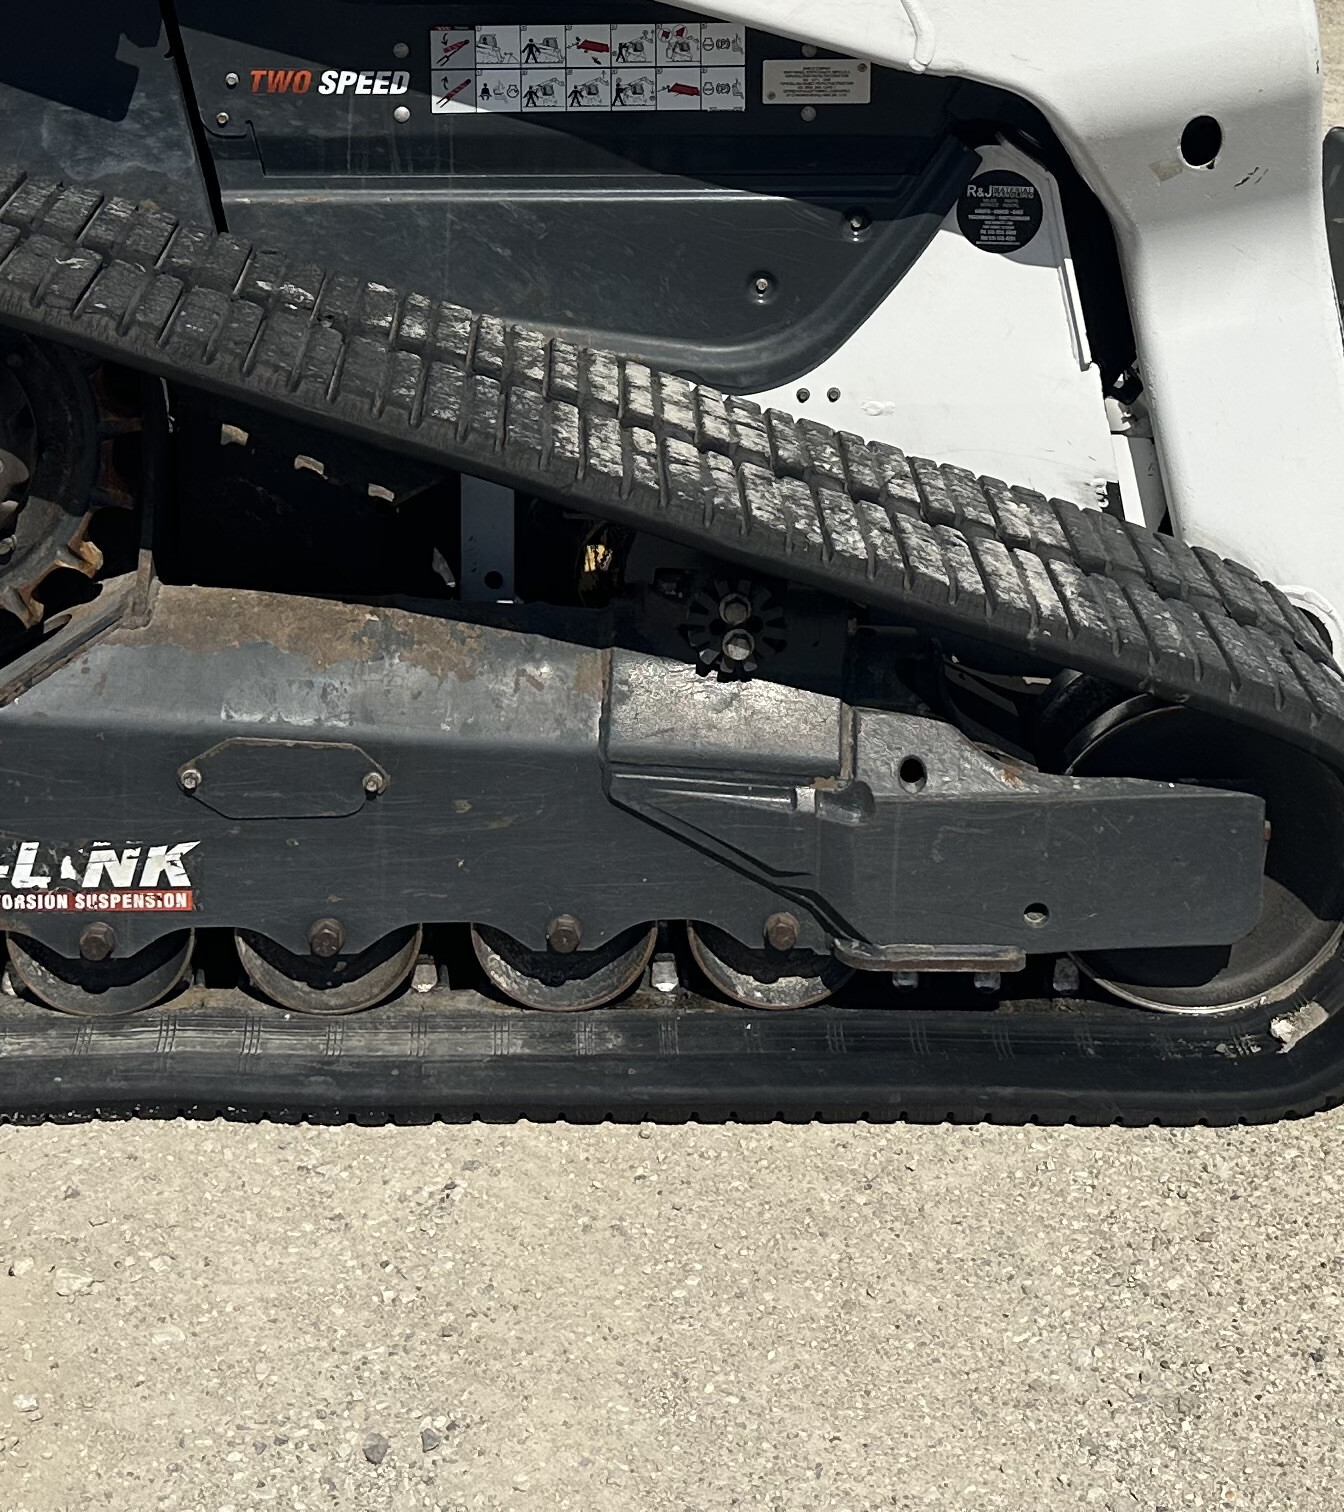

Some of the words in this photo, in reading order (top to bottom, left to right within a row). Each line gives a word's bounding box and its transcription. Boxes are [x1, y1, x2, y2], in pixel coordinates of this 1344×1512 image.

[250, 69, 313, 95] TWO
[318, 69, 411, 95] SPEED
[966, 184, 992, 198] R&J
[74, 892, 188, 910] SUSPENSION
